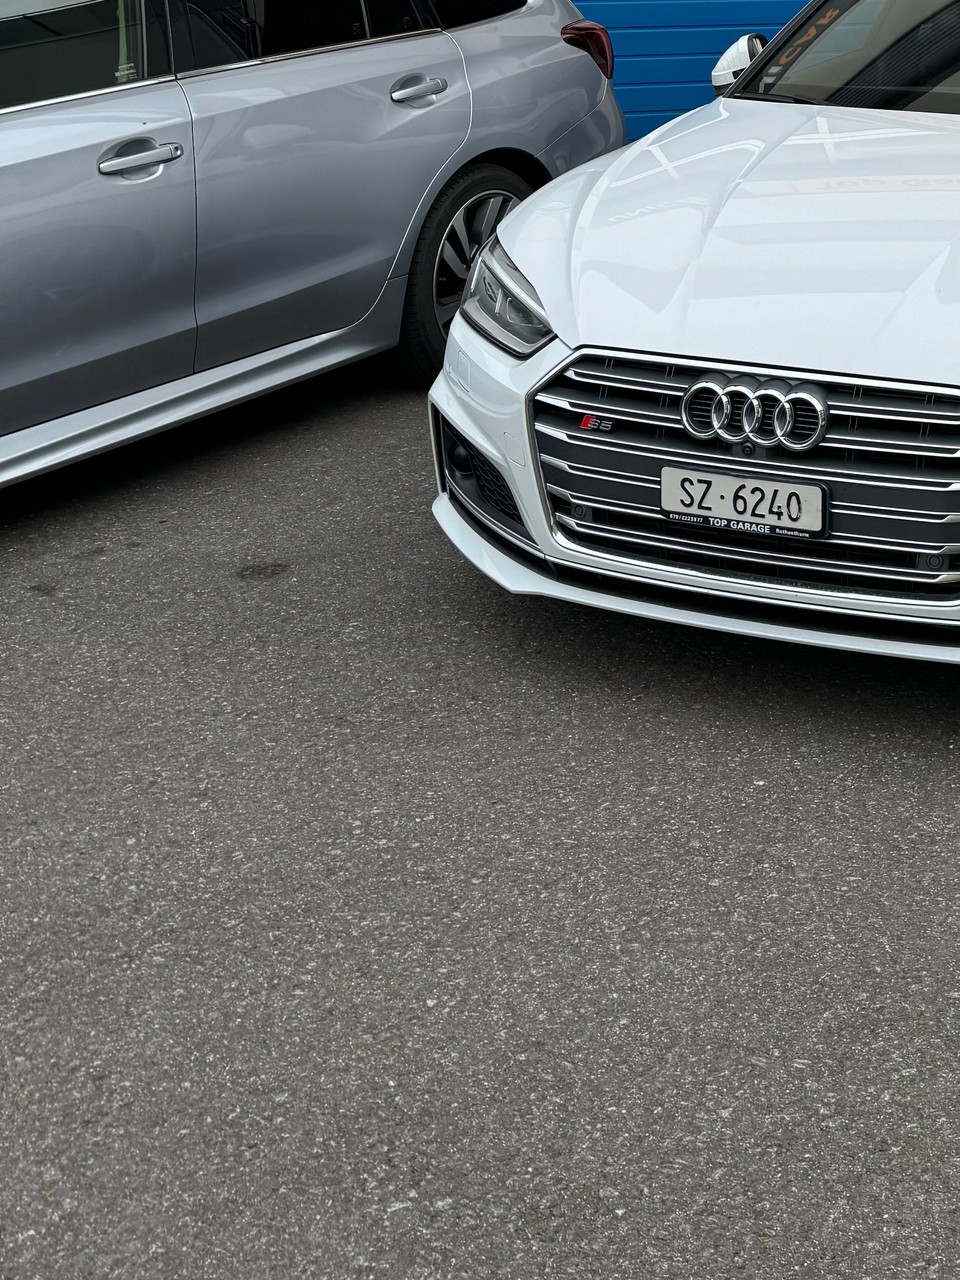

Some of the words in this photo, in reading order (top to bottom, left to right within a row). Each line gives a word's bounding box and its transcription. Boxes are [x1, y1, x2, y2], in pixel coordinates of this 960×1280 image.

[586, 418, 613, 431] S5
[732, 484, 803, 523] 6240
[708, 517, 728, 528] TOP
[730, 520, 771, 534] GARAGE
